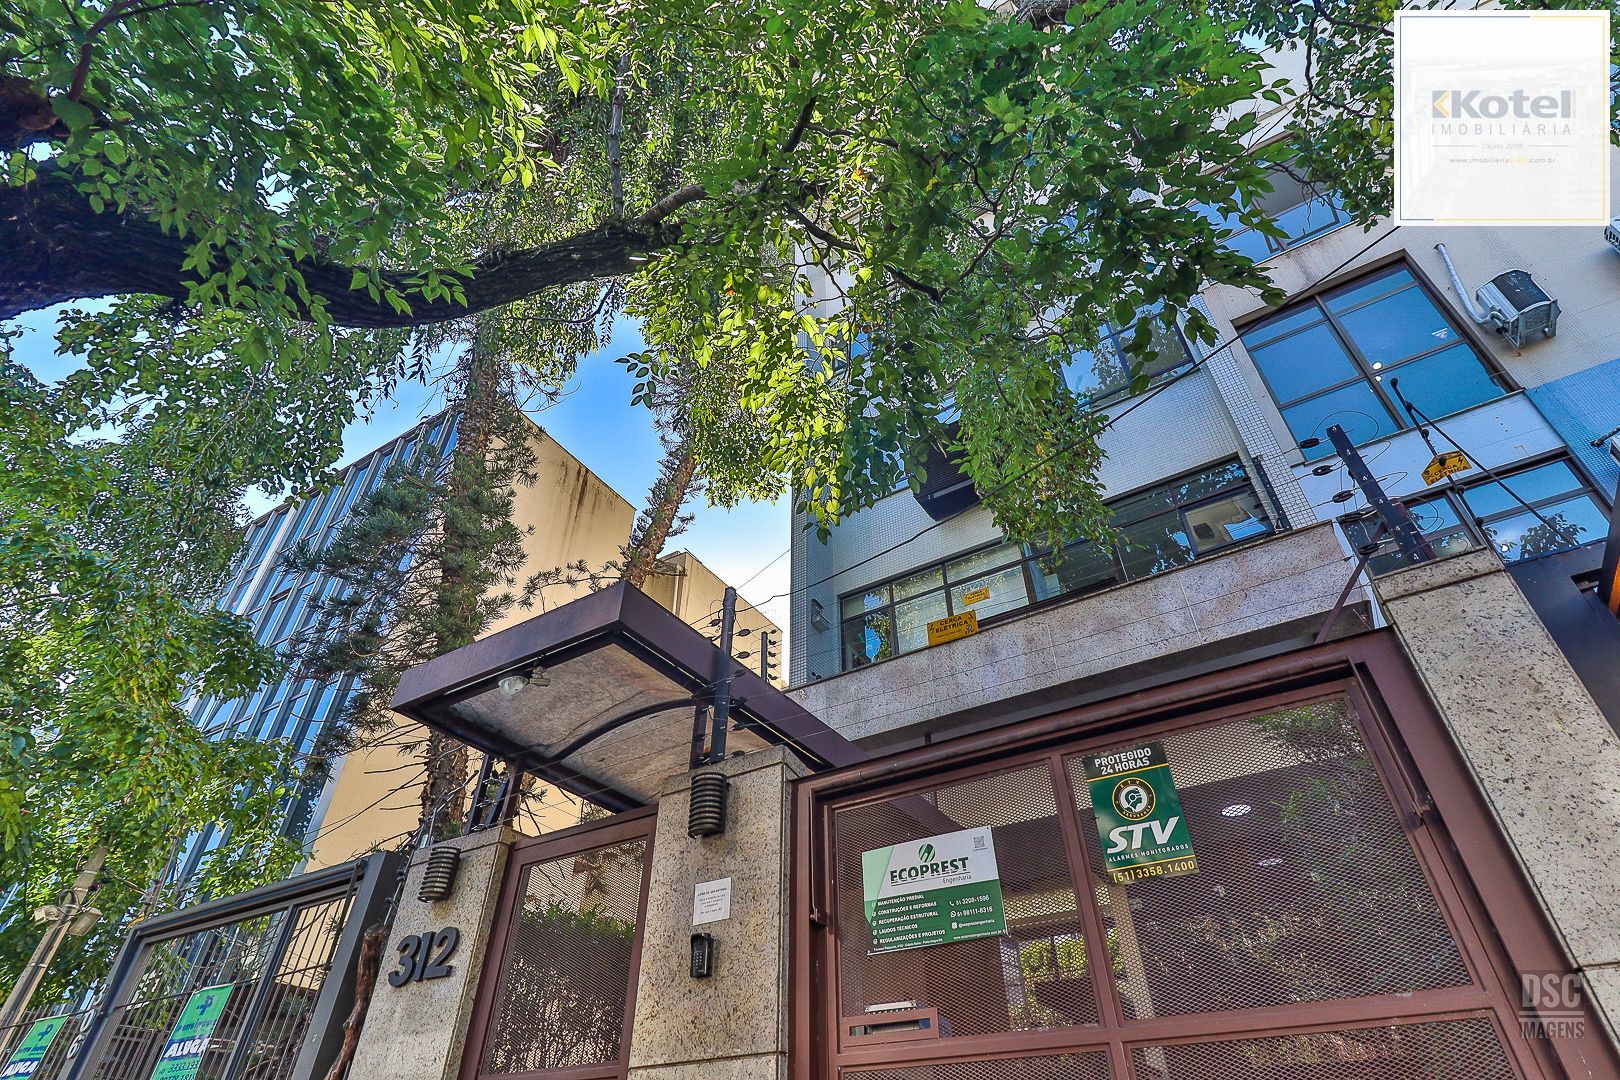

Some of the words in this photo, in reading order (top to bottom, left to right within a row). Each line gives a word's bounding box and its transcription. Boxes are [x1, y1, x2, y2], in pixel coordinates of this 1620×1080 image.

[940, 615, 963, 626] CERCA
[1094, 748, 1152, 768] PROTEGIDO
[1100, 765, 1114, 776] 24
[1114, 758, 1150, 773] HORAS
[1107, 816, 1180, 854] STV
[1108, 852, 1138, 863] ALARMES
[1140, 843, 1189, 857] MONITORADOS
[890, 857, 969, 882] ECOPREST
[942, 874, 972, 884] Engenharia
[878, 896, 906, 906] MANUTENÇÃO
[913, 902, 937, 910] REFORMAS
[910, 911, 938, 920] ESTRUTURAL
[922, 930, 946, 938] PROJETOS
[388, 926, 460, 988] 312
[163, 1038, 210, 1058] ALUGA
